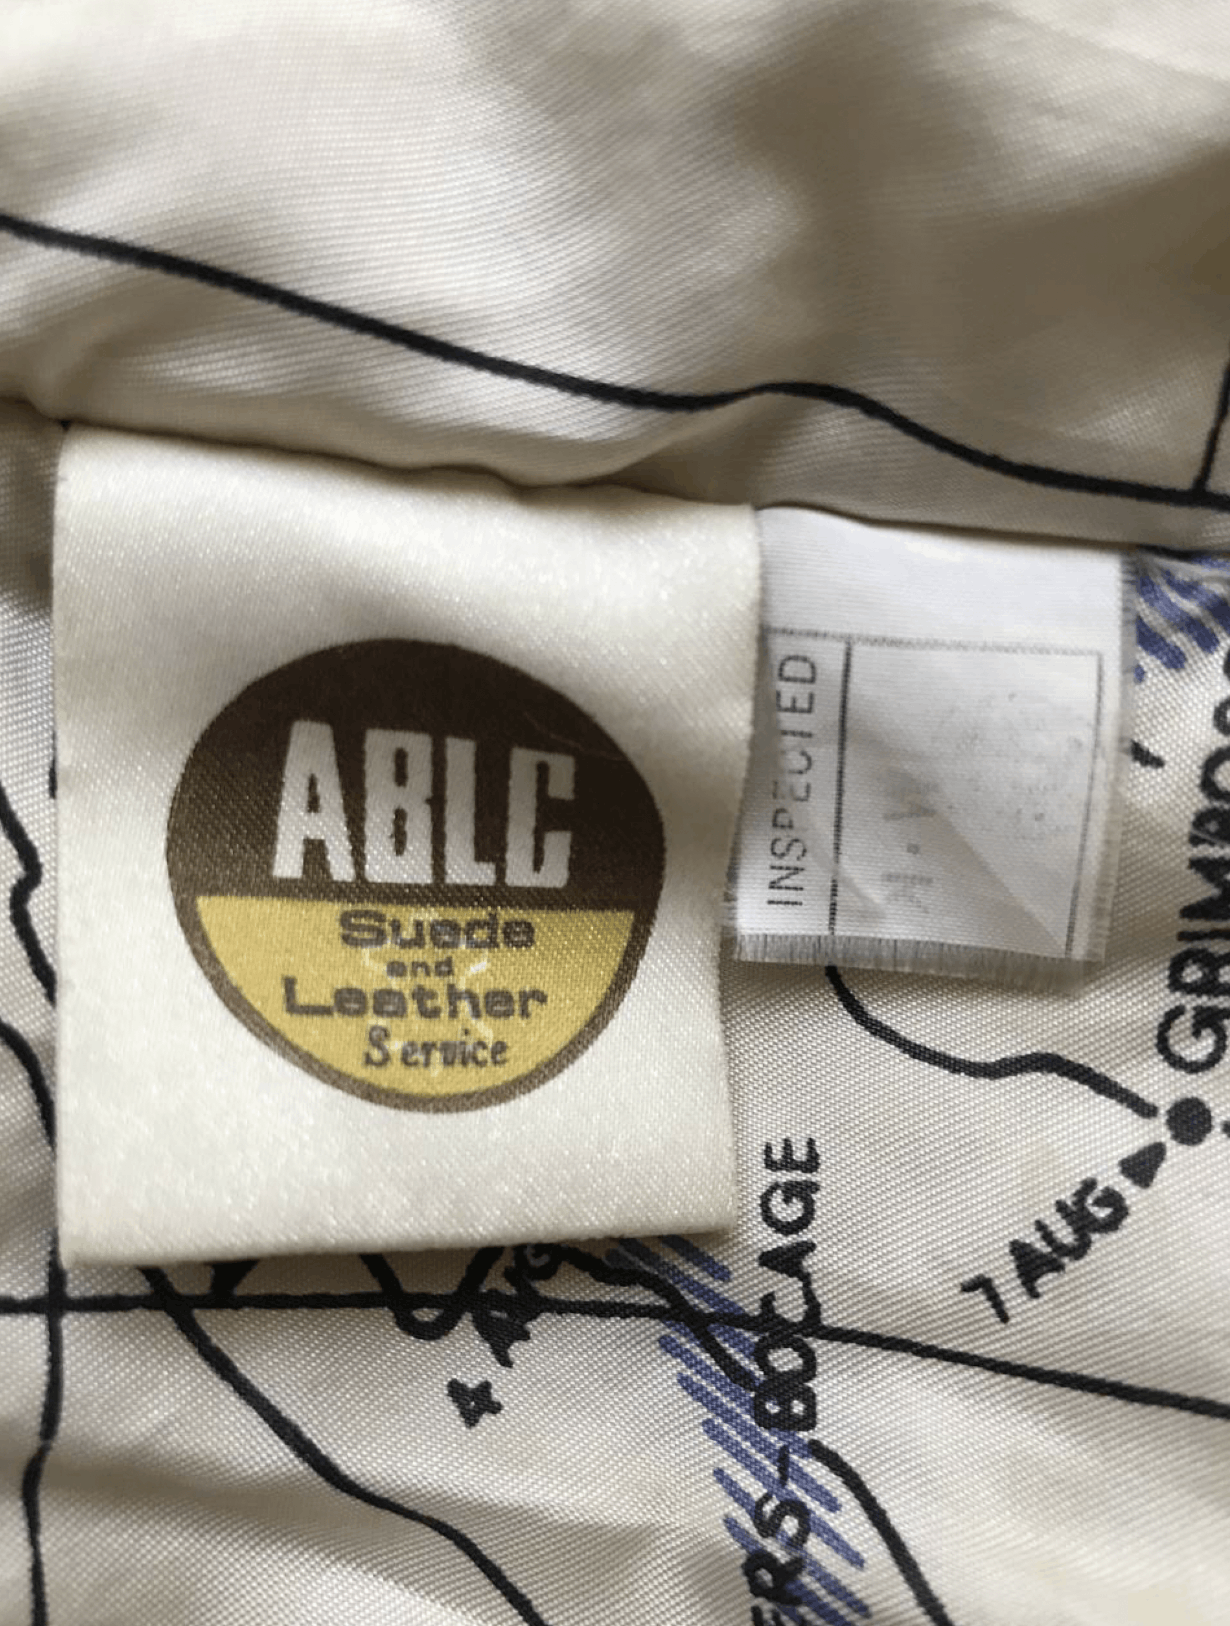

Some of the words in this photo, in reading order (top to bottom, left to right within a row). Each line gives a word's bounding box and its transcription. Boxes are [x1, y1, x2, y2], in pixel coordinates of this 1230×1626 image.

[272, 719, 576, 890] ABLC
[339, 909, 536, 949] Suede
[386, 956, 455, 978] and
[282, 975, 549, 1020] Leather
[362, 1025, 509, 1069] Service
[959, 1273, 1010, 1325] 7
[1009, 1176, 1131, 1299] AUG
